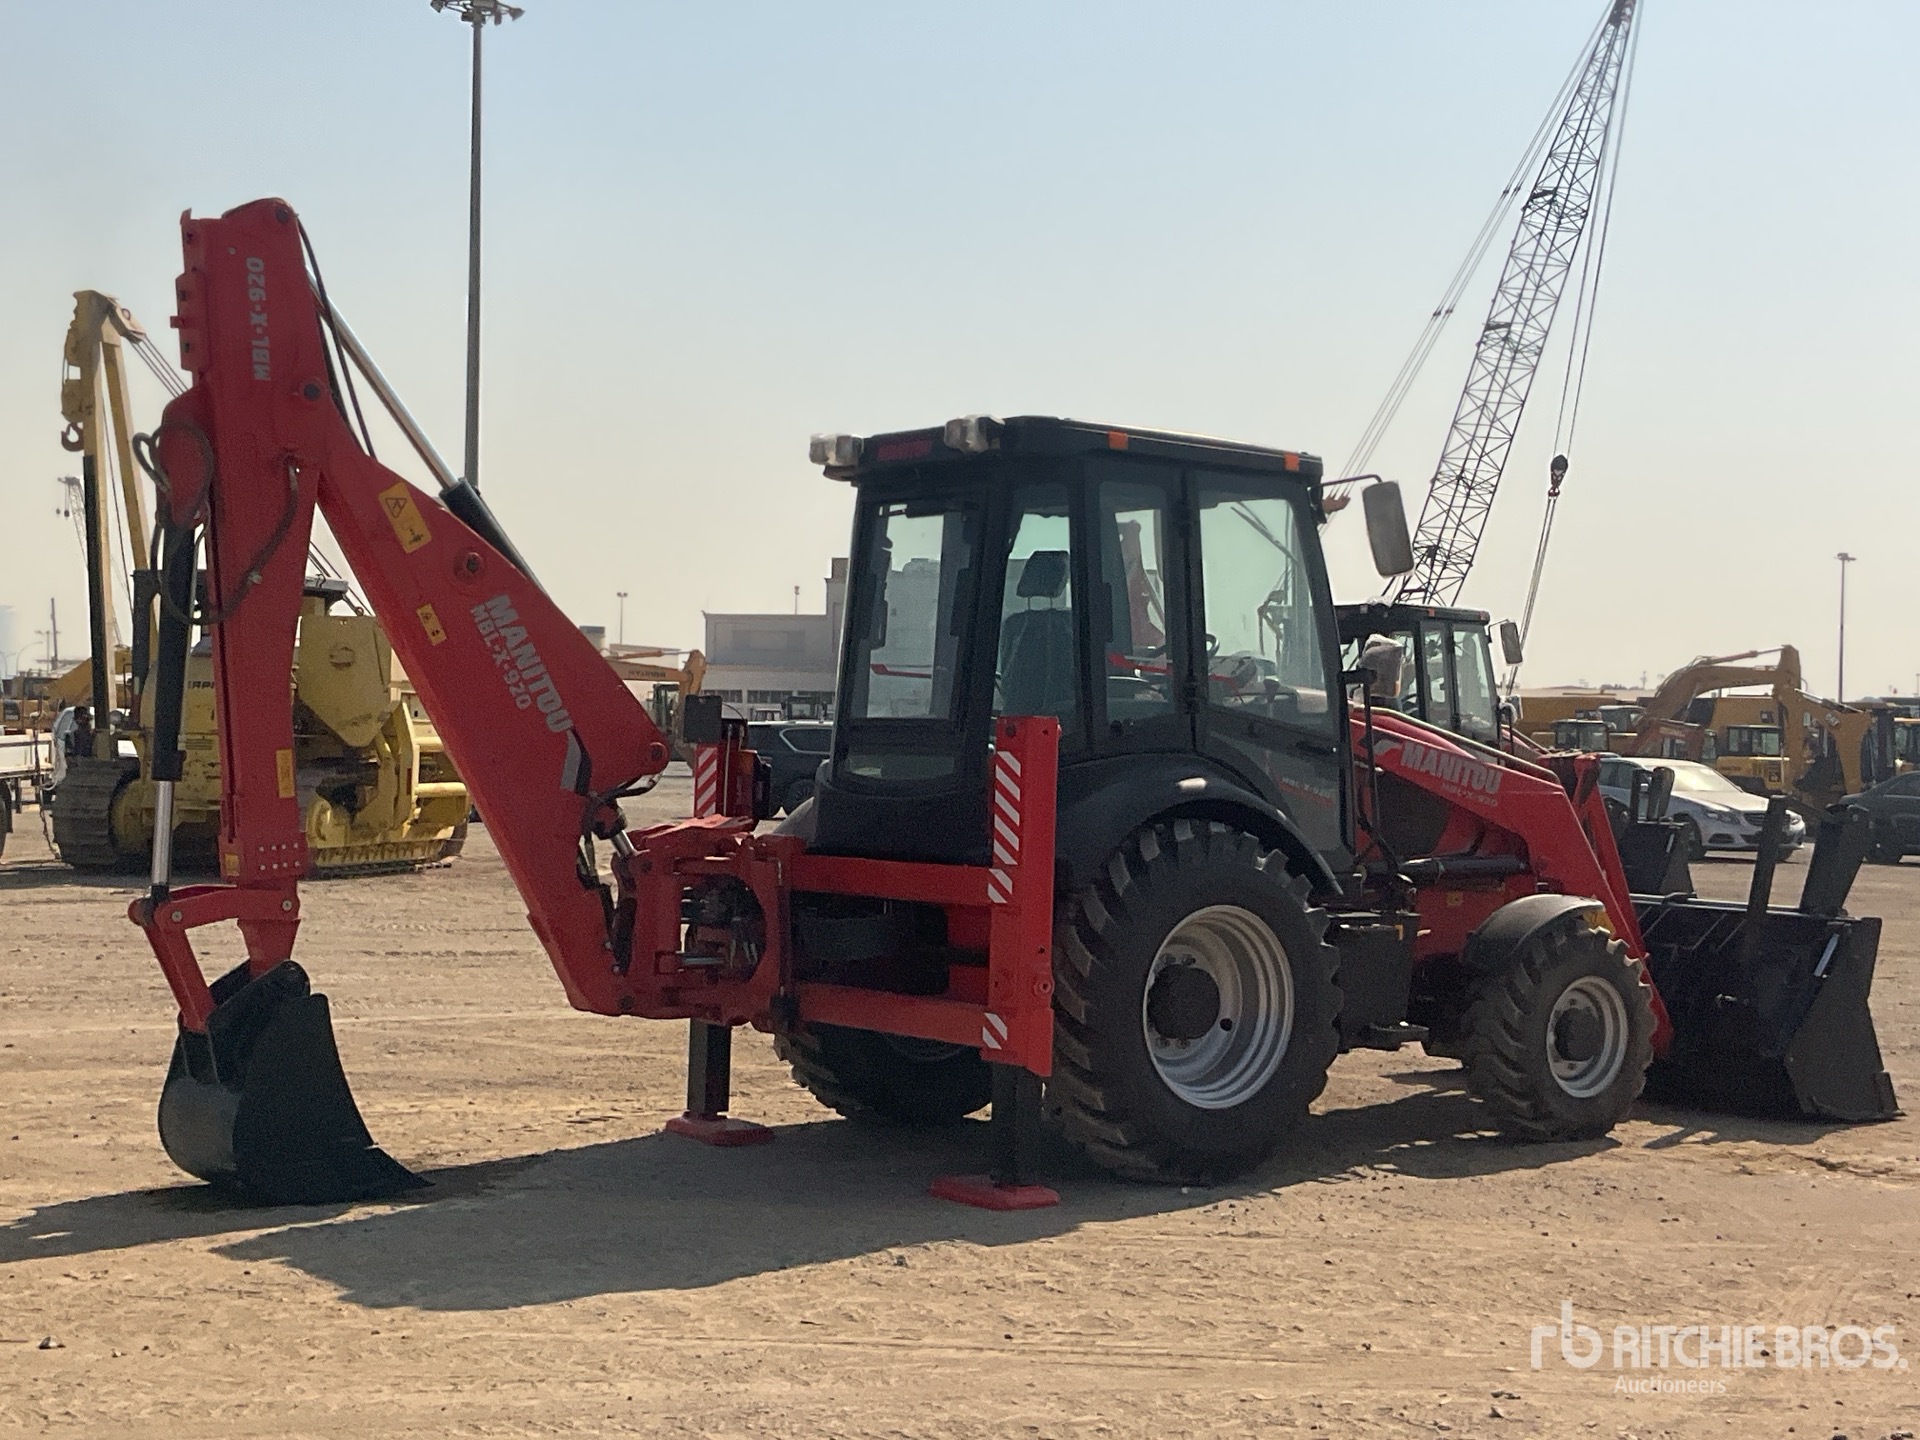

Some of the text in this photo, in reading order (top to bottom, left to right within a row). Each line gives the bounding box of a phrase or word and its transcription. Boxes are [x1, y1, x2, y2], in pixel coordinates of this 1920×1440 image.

[246, 256, 271, 381] MBL-X-920
[470, 603, 532, 709] MBL-X-920
[484, 594, 574, 733] MANITOU
[1400, 741, 1503, 794] MANITOU
